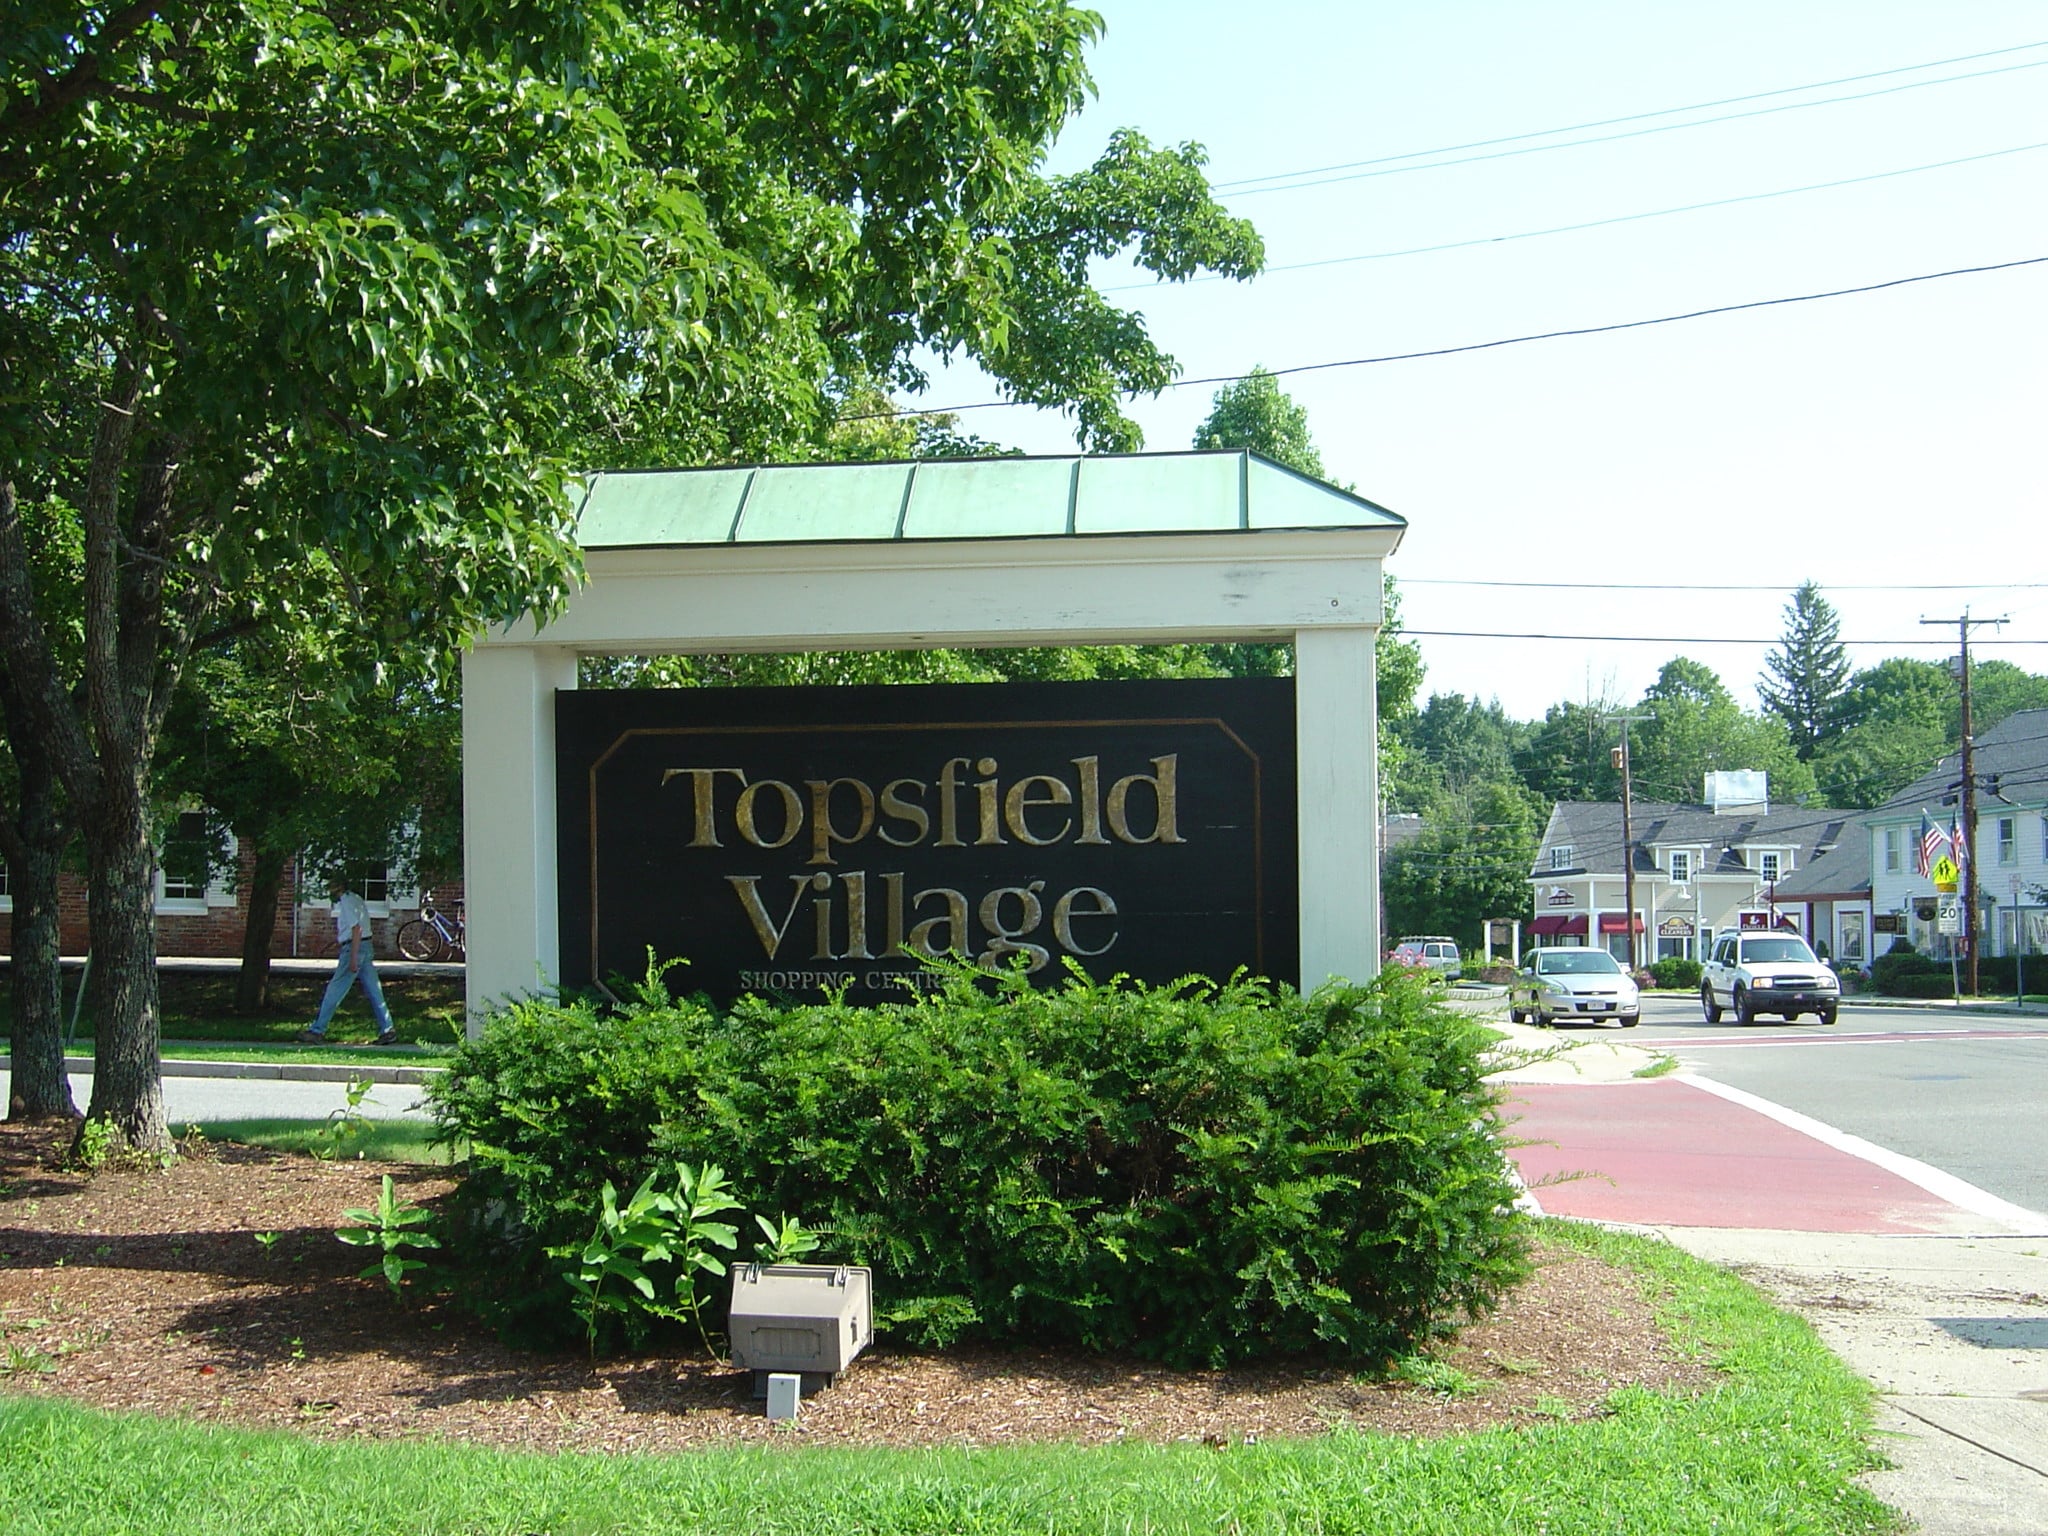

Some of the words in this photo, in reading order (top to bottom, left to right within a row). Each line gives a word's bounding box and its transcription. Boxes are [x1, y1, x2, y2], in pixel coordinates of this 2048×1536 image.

[660, 753, 1188, 866] Topsfield
[723, 870, 1119, 974] Village
[1940, 907, 1957, 919] 20
[740, 971, 855, 990] SHOPPING
[865, 971, 946, 990] CENTR
